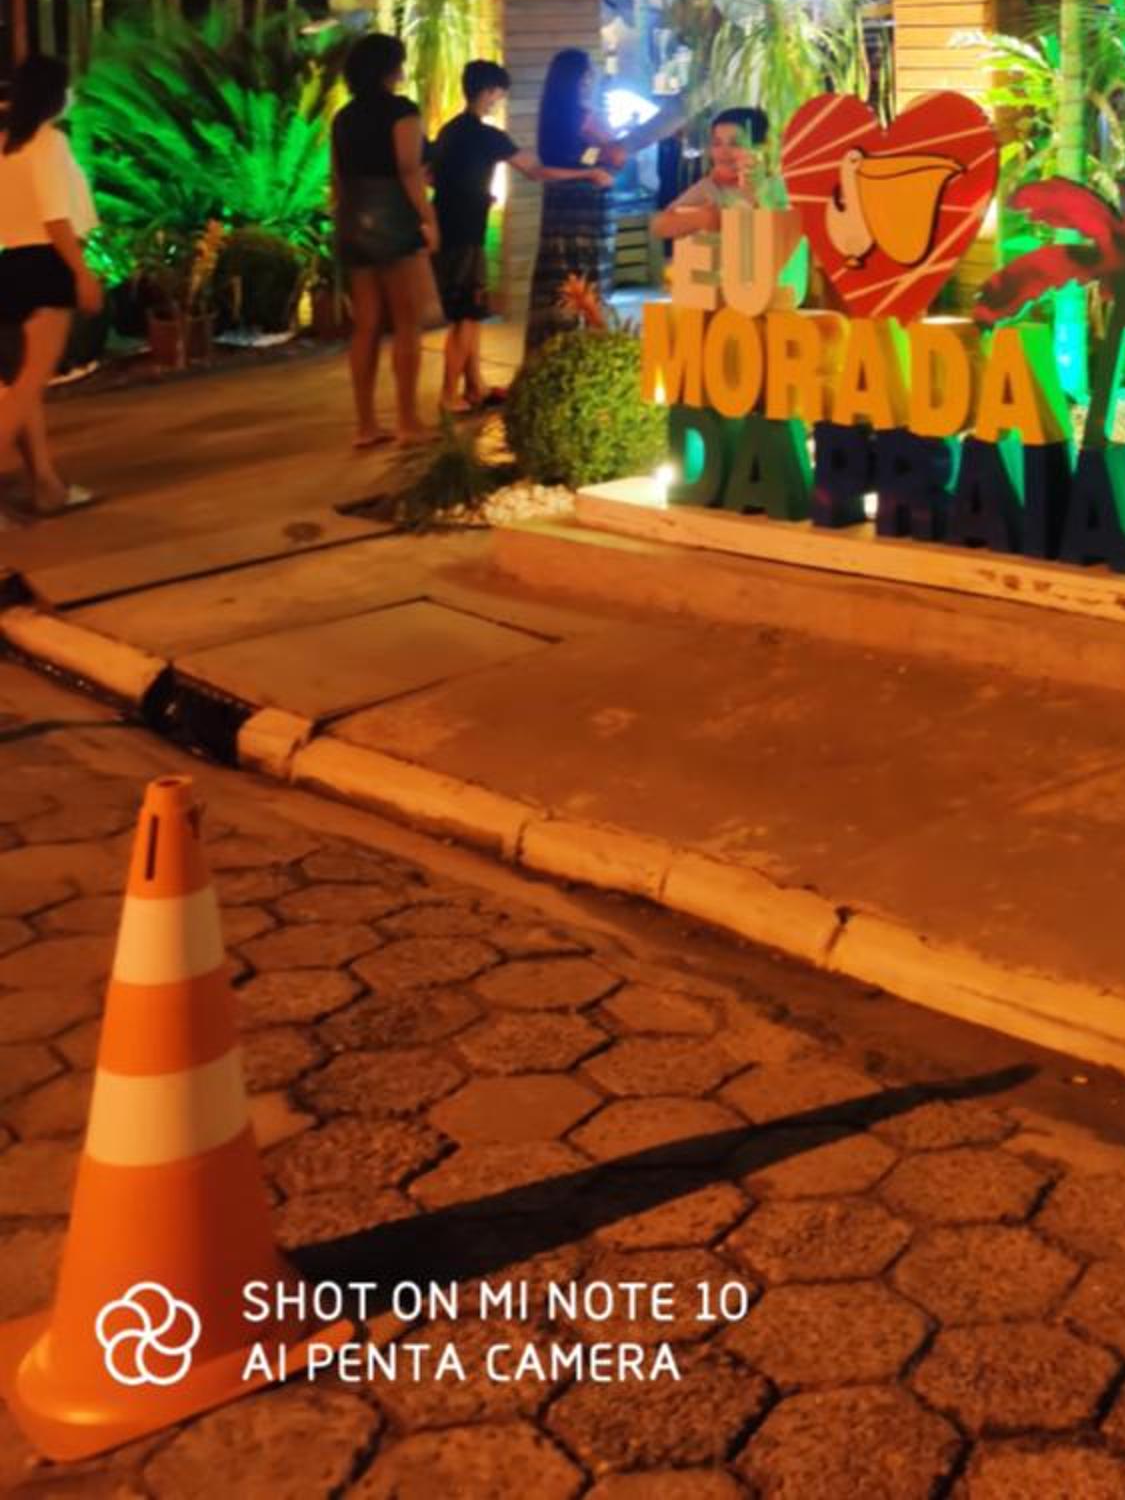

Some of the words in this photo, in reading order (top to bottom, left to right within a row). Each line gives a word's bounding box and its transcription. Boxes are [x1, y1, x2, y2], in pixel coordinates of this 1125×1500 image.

[671, 202, 776, 316] EU
[640, 302, 1052, 445] MORADA
[668, 408, 803, 521] DA
